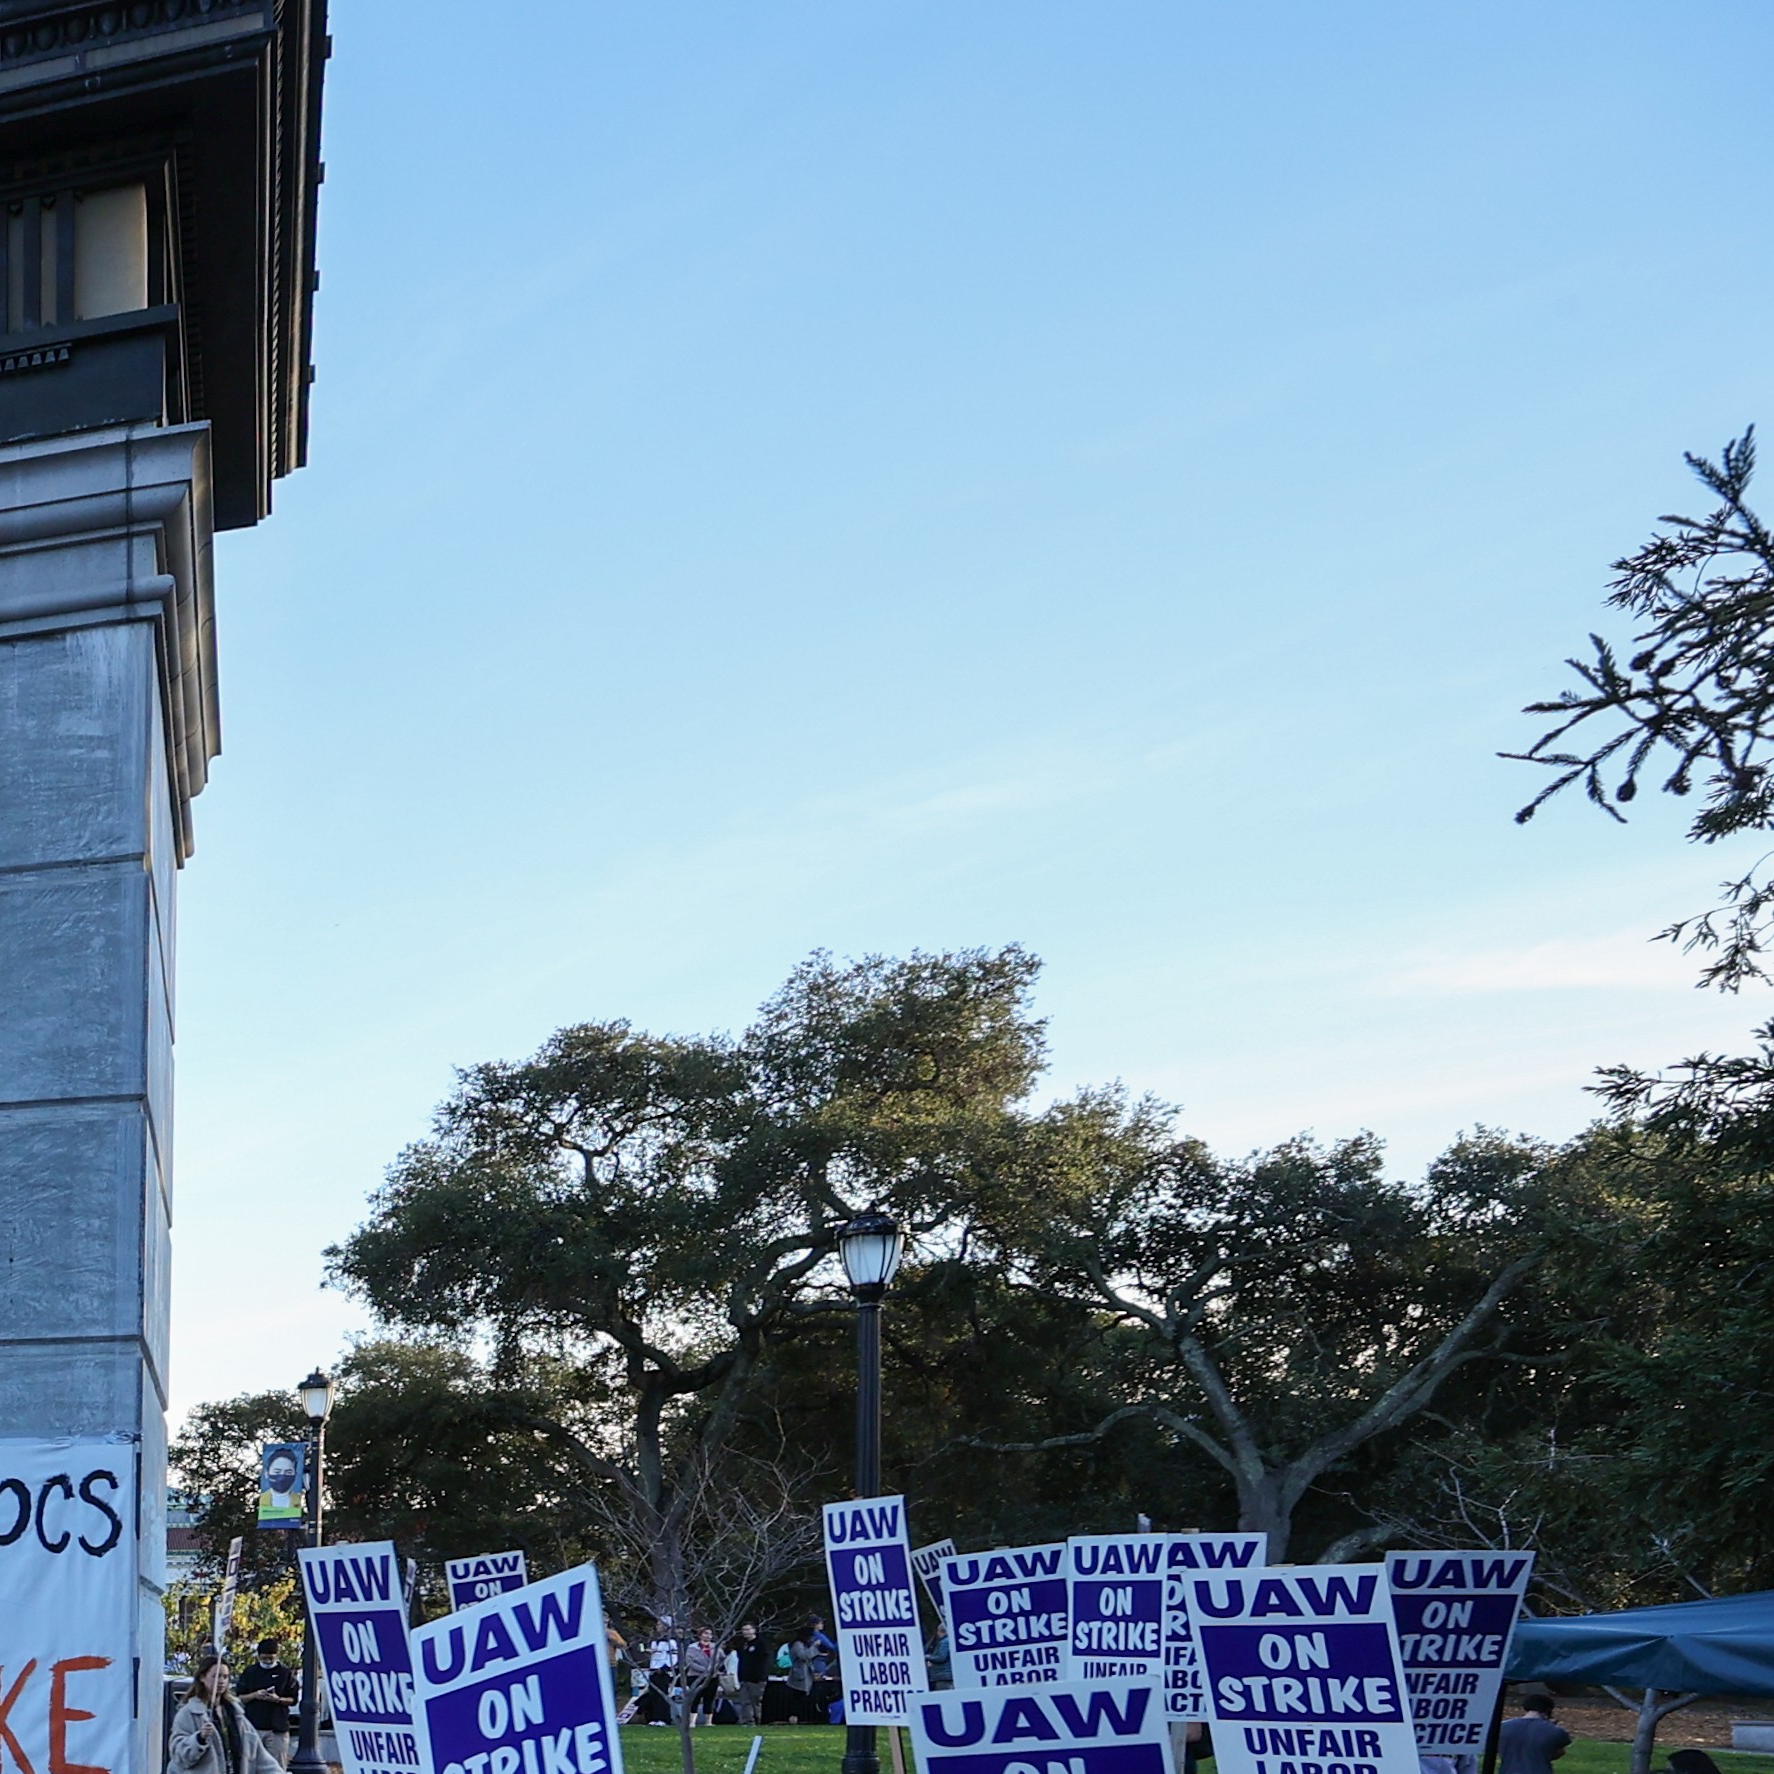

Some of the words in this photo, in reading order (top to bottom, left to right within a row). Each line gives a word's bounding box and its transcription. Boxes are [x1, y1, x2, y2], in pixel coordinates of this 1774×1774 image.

[828, 1505, 898, 1544] UAW
[452, 1554, 520, 1580] UAW
[854, 1552, 885, 1585] ON
[947, 1550, 1063, 1586] UAW
[1074, 1543, 1163, 1575] UAW
[1392, 1559, 1527, 1589] UAW
[305, 1555, 390, 1604] UAW
[840, 1589, 913, 1622] STRIKE
[987, 1588, 1031, 1615] ON
[1100, 1587, 1133, 1616] ON
[1194, 1575, 1378, 1619] UAW
[958, 1612, 1068, 1646] STRIKE
[1421, 1601, 1474, 1629] ON
[342, 1620, 380, 1664] ON
[421, 1581, 586, 1686] UAW
[853, 1634, 910, 1657] UNFAIR
[1075, 1621, 1158, 1651] STRIKE
[974, 1646, 1060, 1672] UNFAIR
[1259, 1632, 1329, 1670] ON
[859, 1662, 910, 1685] LABOR
[331, 1671, 414, 1715] STRIKE
[478, 1673, 545, 1739] ON
[1217, 1676, 1395, 1715] STRIKE
[922, 1687, 1151, 1747] UAW
[350, 1730, 419, 1766] UNFAIR
[1244, 1728, 1382, 1757] UNFAIR
